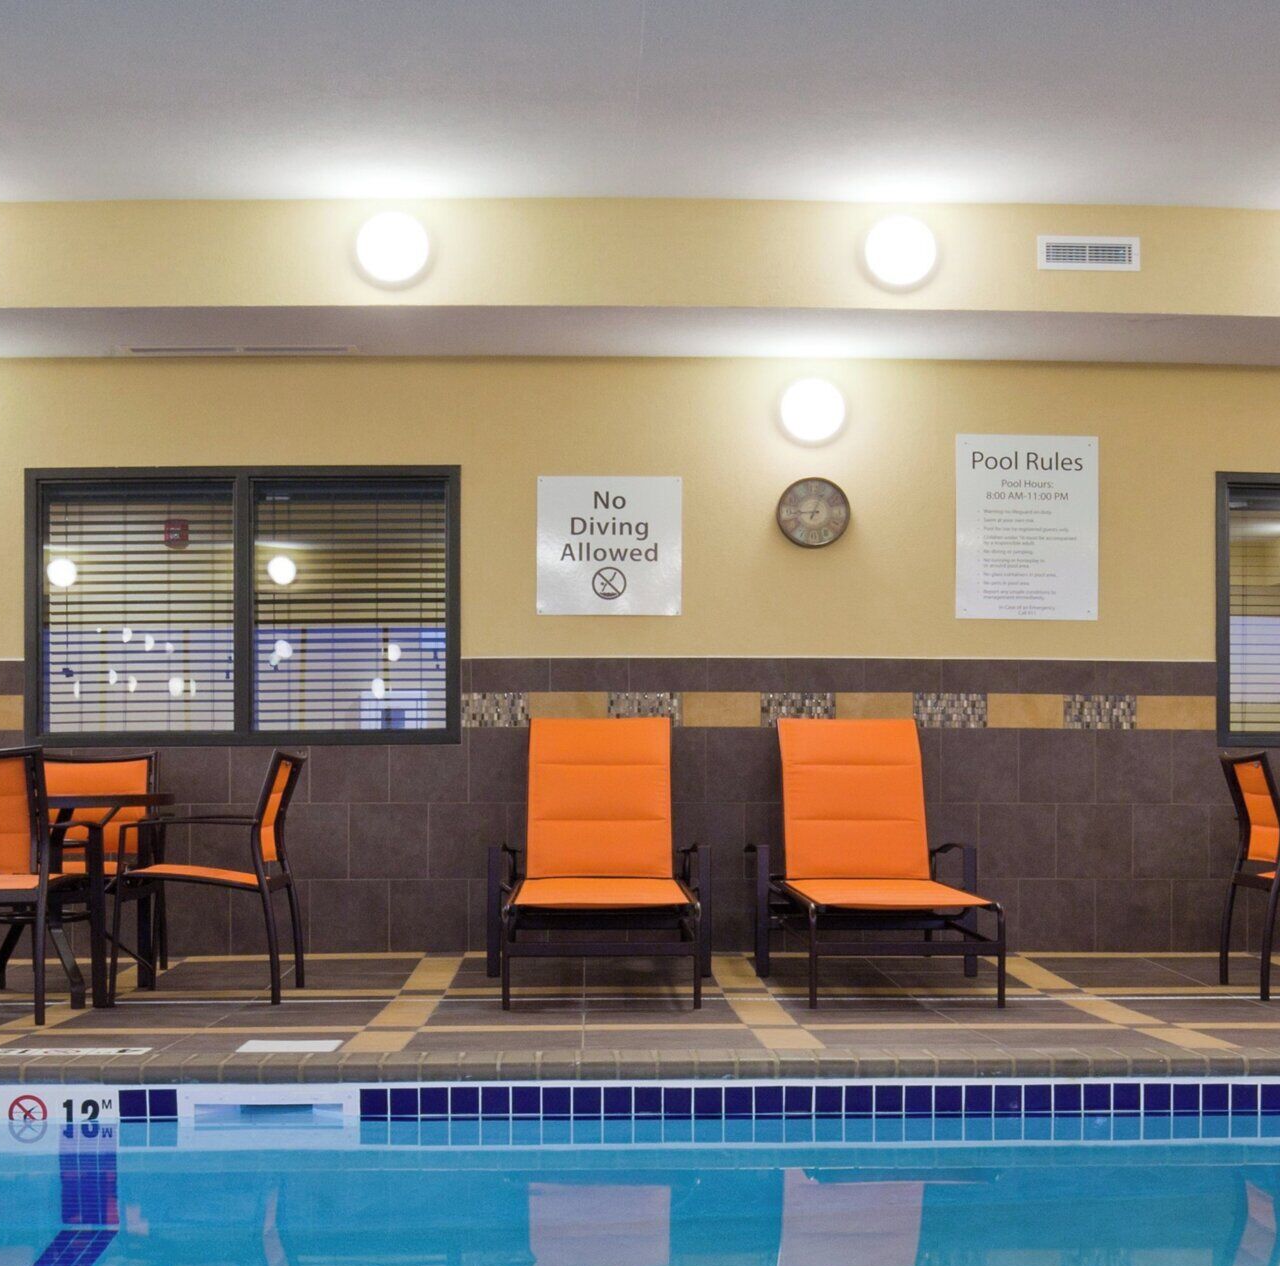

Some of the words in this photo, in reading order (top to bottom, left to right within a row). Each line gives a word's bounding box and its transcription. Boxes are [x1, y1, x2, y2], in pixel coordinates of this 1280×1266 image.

[972, 451, 1018, 470] Pool
[1026, 452, 1083, 471] Rules
[1001, 479, 1021, 488] Pool
[1024, 480, 1054, 488] Hours:
[594, 491, 626, 510] No
[986, 492, 1006, 500] 8:00
[1055, 493, 1069, 501] PM
[570, 517, 649, 541] Diving
[560, 542, 658, 562] Allowed
[102, 1099, 112, 1109] M
